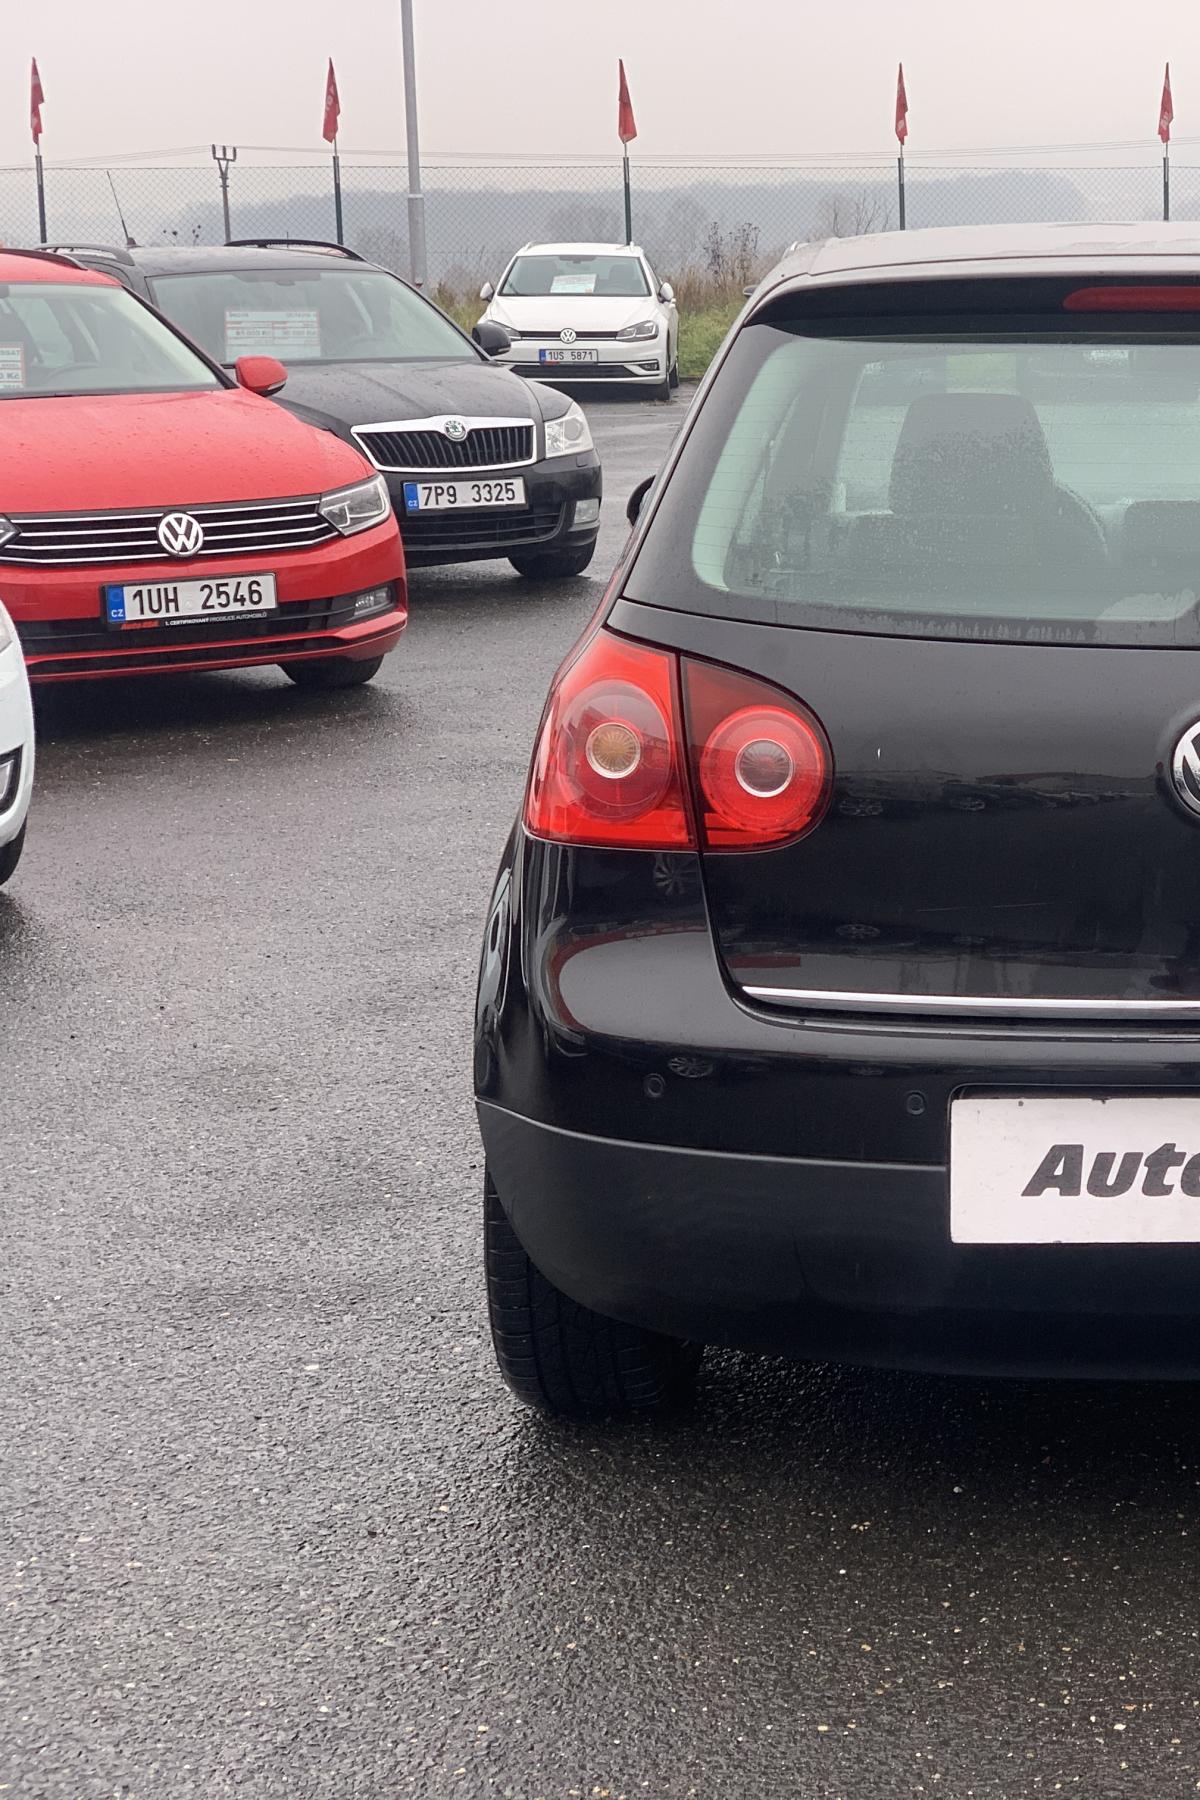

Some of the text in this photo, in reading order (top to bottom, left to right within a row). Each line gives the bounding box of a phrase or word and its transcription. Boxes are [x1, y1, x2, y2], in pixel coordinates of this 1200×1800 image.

[548, 351, 593, 361] 1US 5871
[422, 485, 457, 506] 7P9
[471, 482, 516, 503] 3325
[111, 580, 263, 618] CZ 1UH 2546
